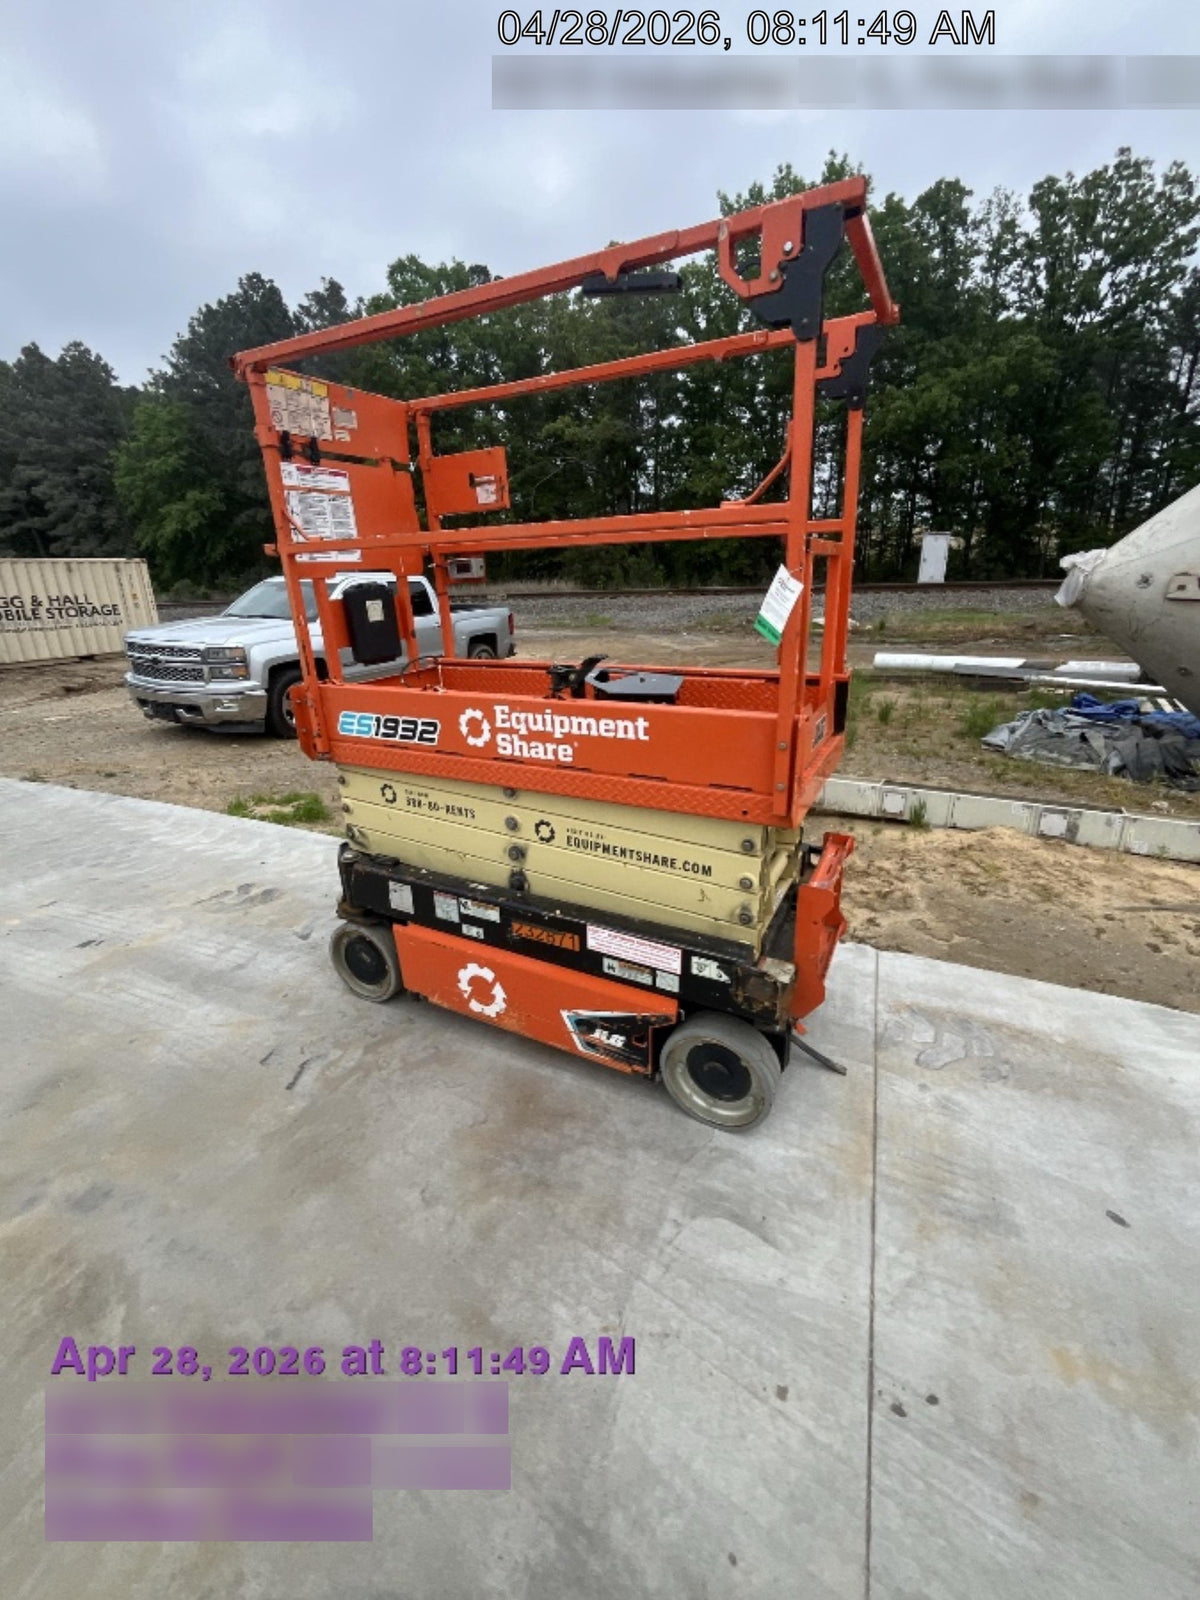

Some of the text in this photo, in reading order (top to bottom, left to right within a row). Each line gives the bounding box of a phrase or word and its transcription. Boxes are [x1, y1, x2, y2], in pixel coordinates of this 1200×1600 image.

[0, 604, 121, 621] BILE STORAGE
[31, 594, 43, 607] &
[47, 594, 93, 607] HALL
[338, 711, 441, 746] ES1932
[494, 705, 650, 741] Equipment
[496, 733, 574, 762] Share
[566, 836, 713, 877] EQUIPMENTSHARE.COM
